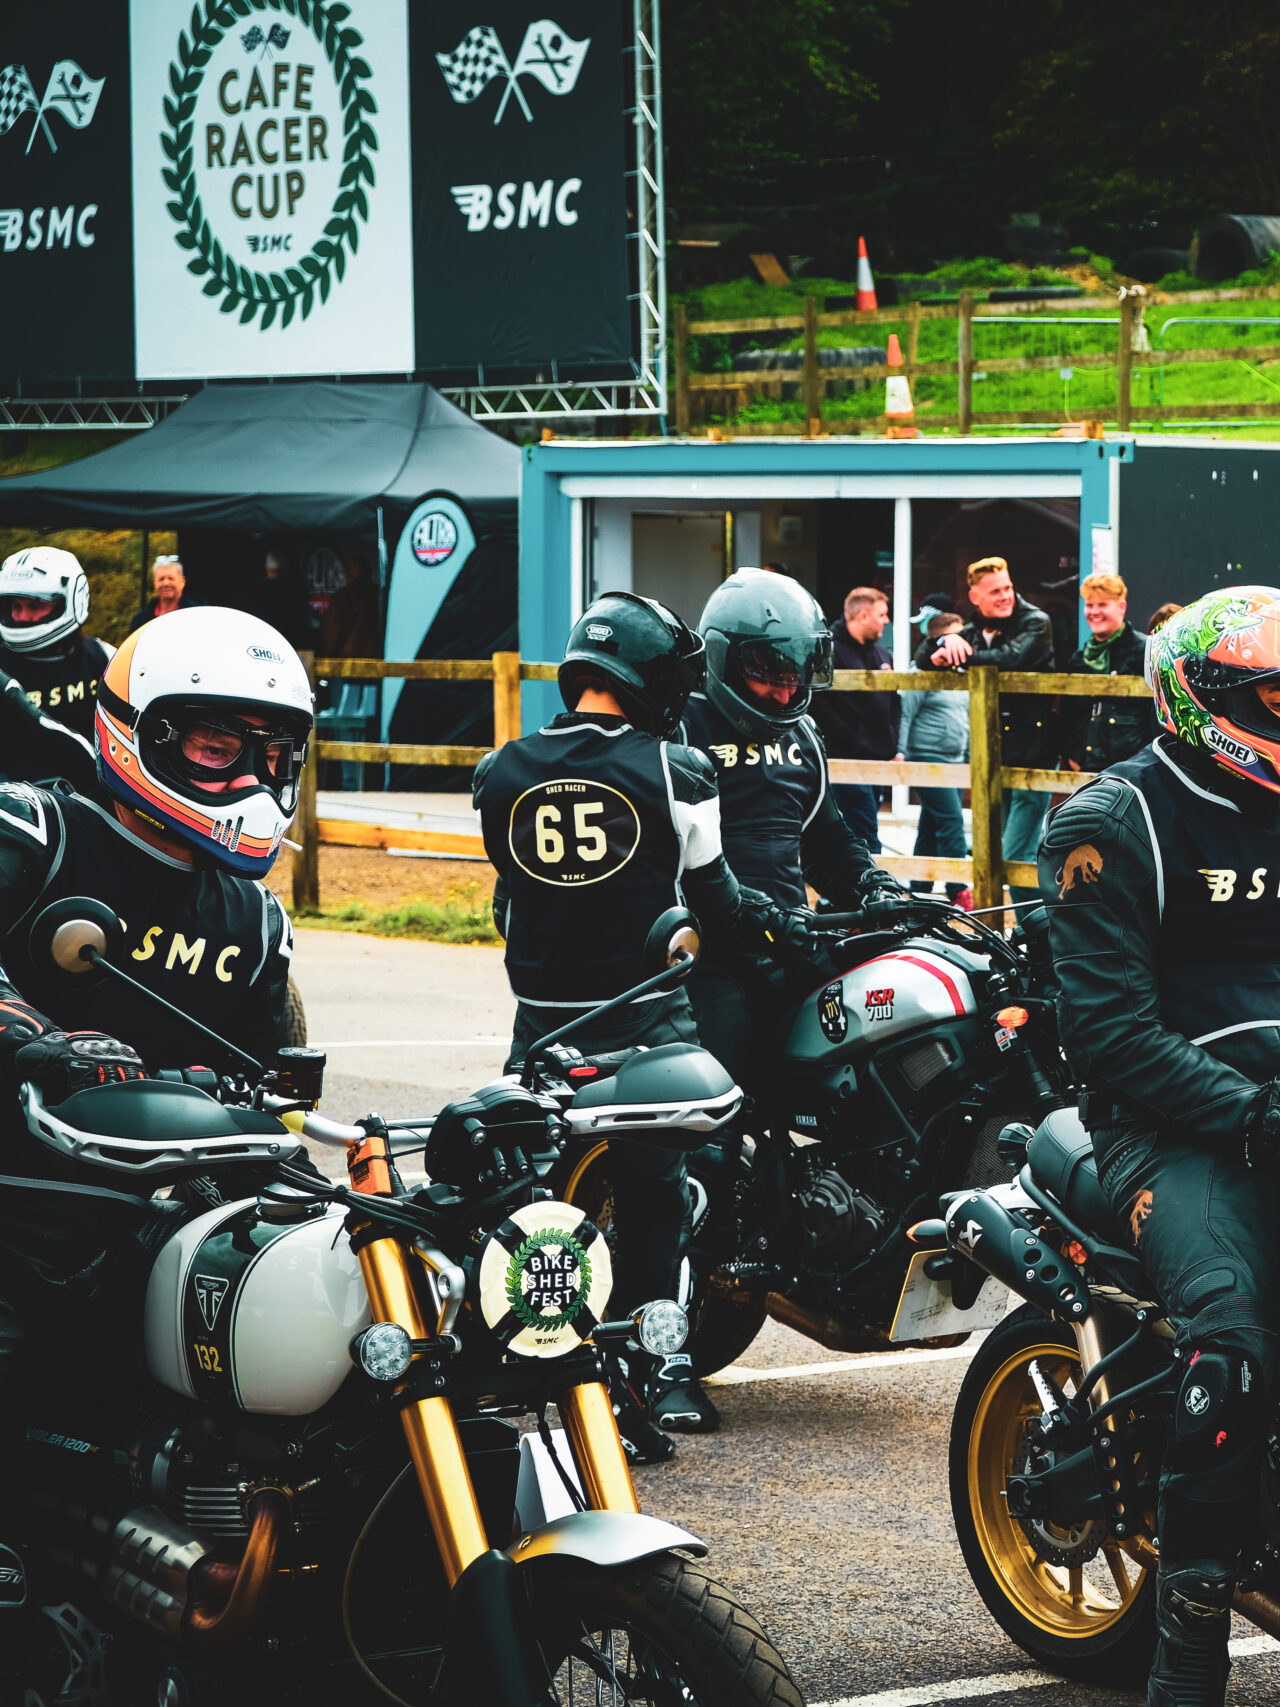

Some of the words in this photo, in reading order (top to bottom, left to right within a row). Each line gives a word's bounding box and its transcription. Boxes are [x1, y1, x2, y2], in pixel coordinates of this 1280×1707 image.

[219, 62, 314, 117] CAFE
[206, 115, 329, 168] RACER
[231, 170, 305, 220] CUP
[450, 178, 583, 232] BSMC
[0, 204, 98, 252] BSMC
[709, 743, 802, 768] BSMC
[1208, 730, 1250, 762] SHOEI
[564, 783, 586, 792] RACER
[536, 802, 607, 862] 65
[865, 988, 895, 1006] XSR
[867, 1004, 893, 1021] 700
[530, 1254, 573, 1272] BIKE
[527, 1272, 577, 1289] SHED
[530, 1289, 573, 1307] FEST
[194, 1343, 222, 1372] 132
[64, 1437, 92, 1453] 1200
